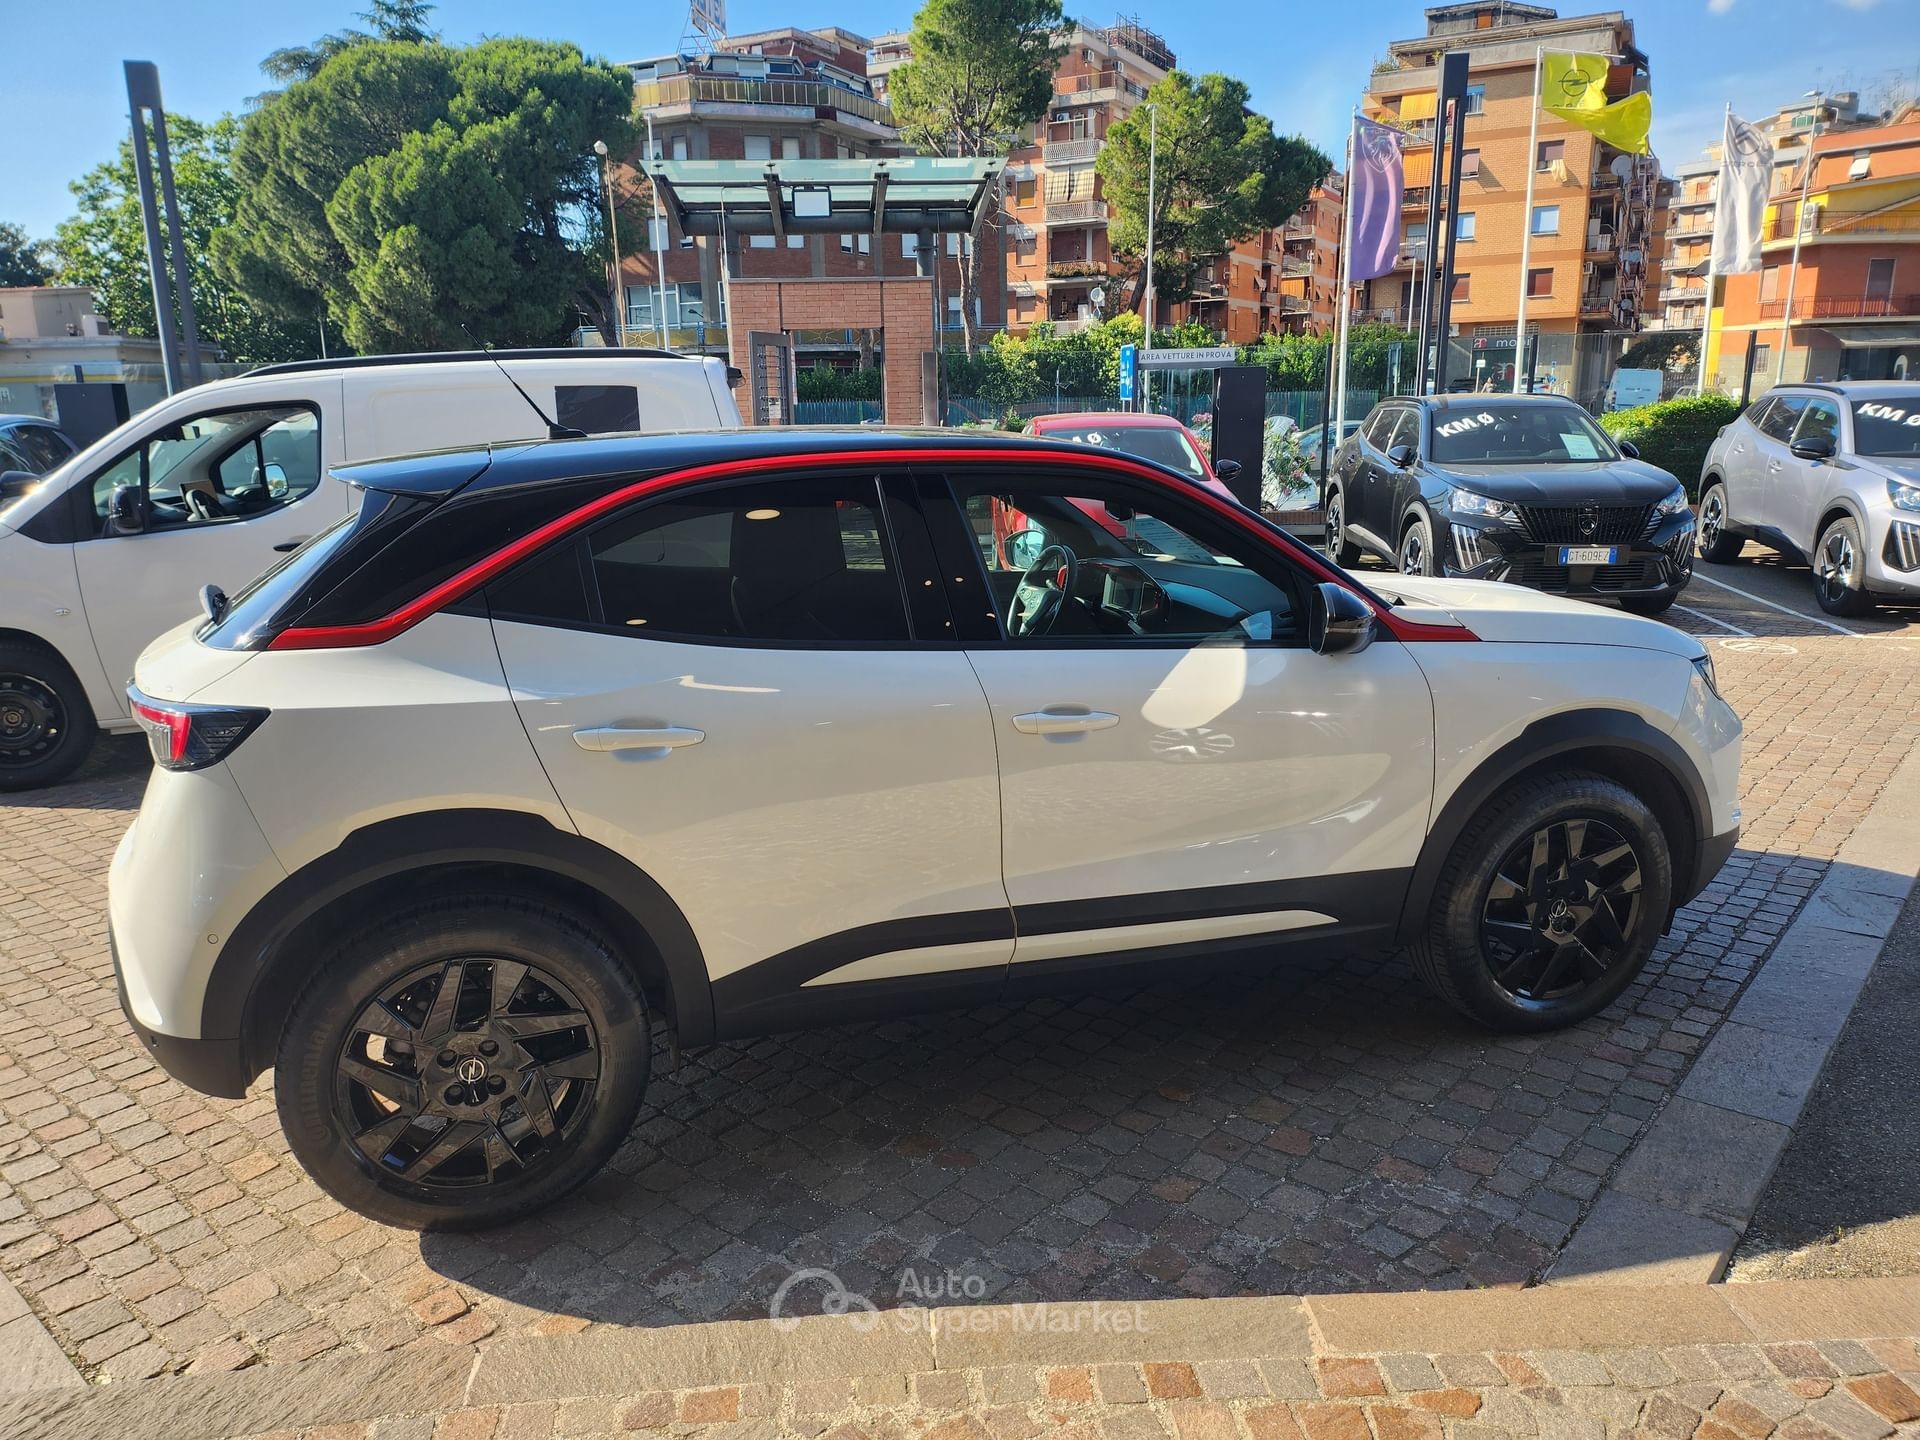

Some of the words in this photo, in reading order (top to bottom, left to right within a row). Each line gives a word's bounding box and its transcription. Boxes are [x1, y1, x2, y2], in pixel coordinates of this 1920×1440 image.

[1140, 352, 1161, 361] AREA
[1162, 351, 1195, 361] VETTURE
[1196, 351, 1205, 359] IN
[1205, 350, 1232, 359] PROVA
[1855, 402, 1905, 422] KM
[1435, 417, 1479, 437] KM
